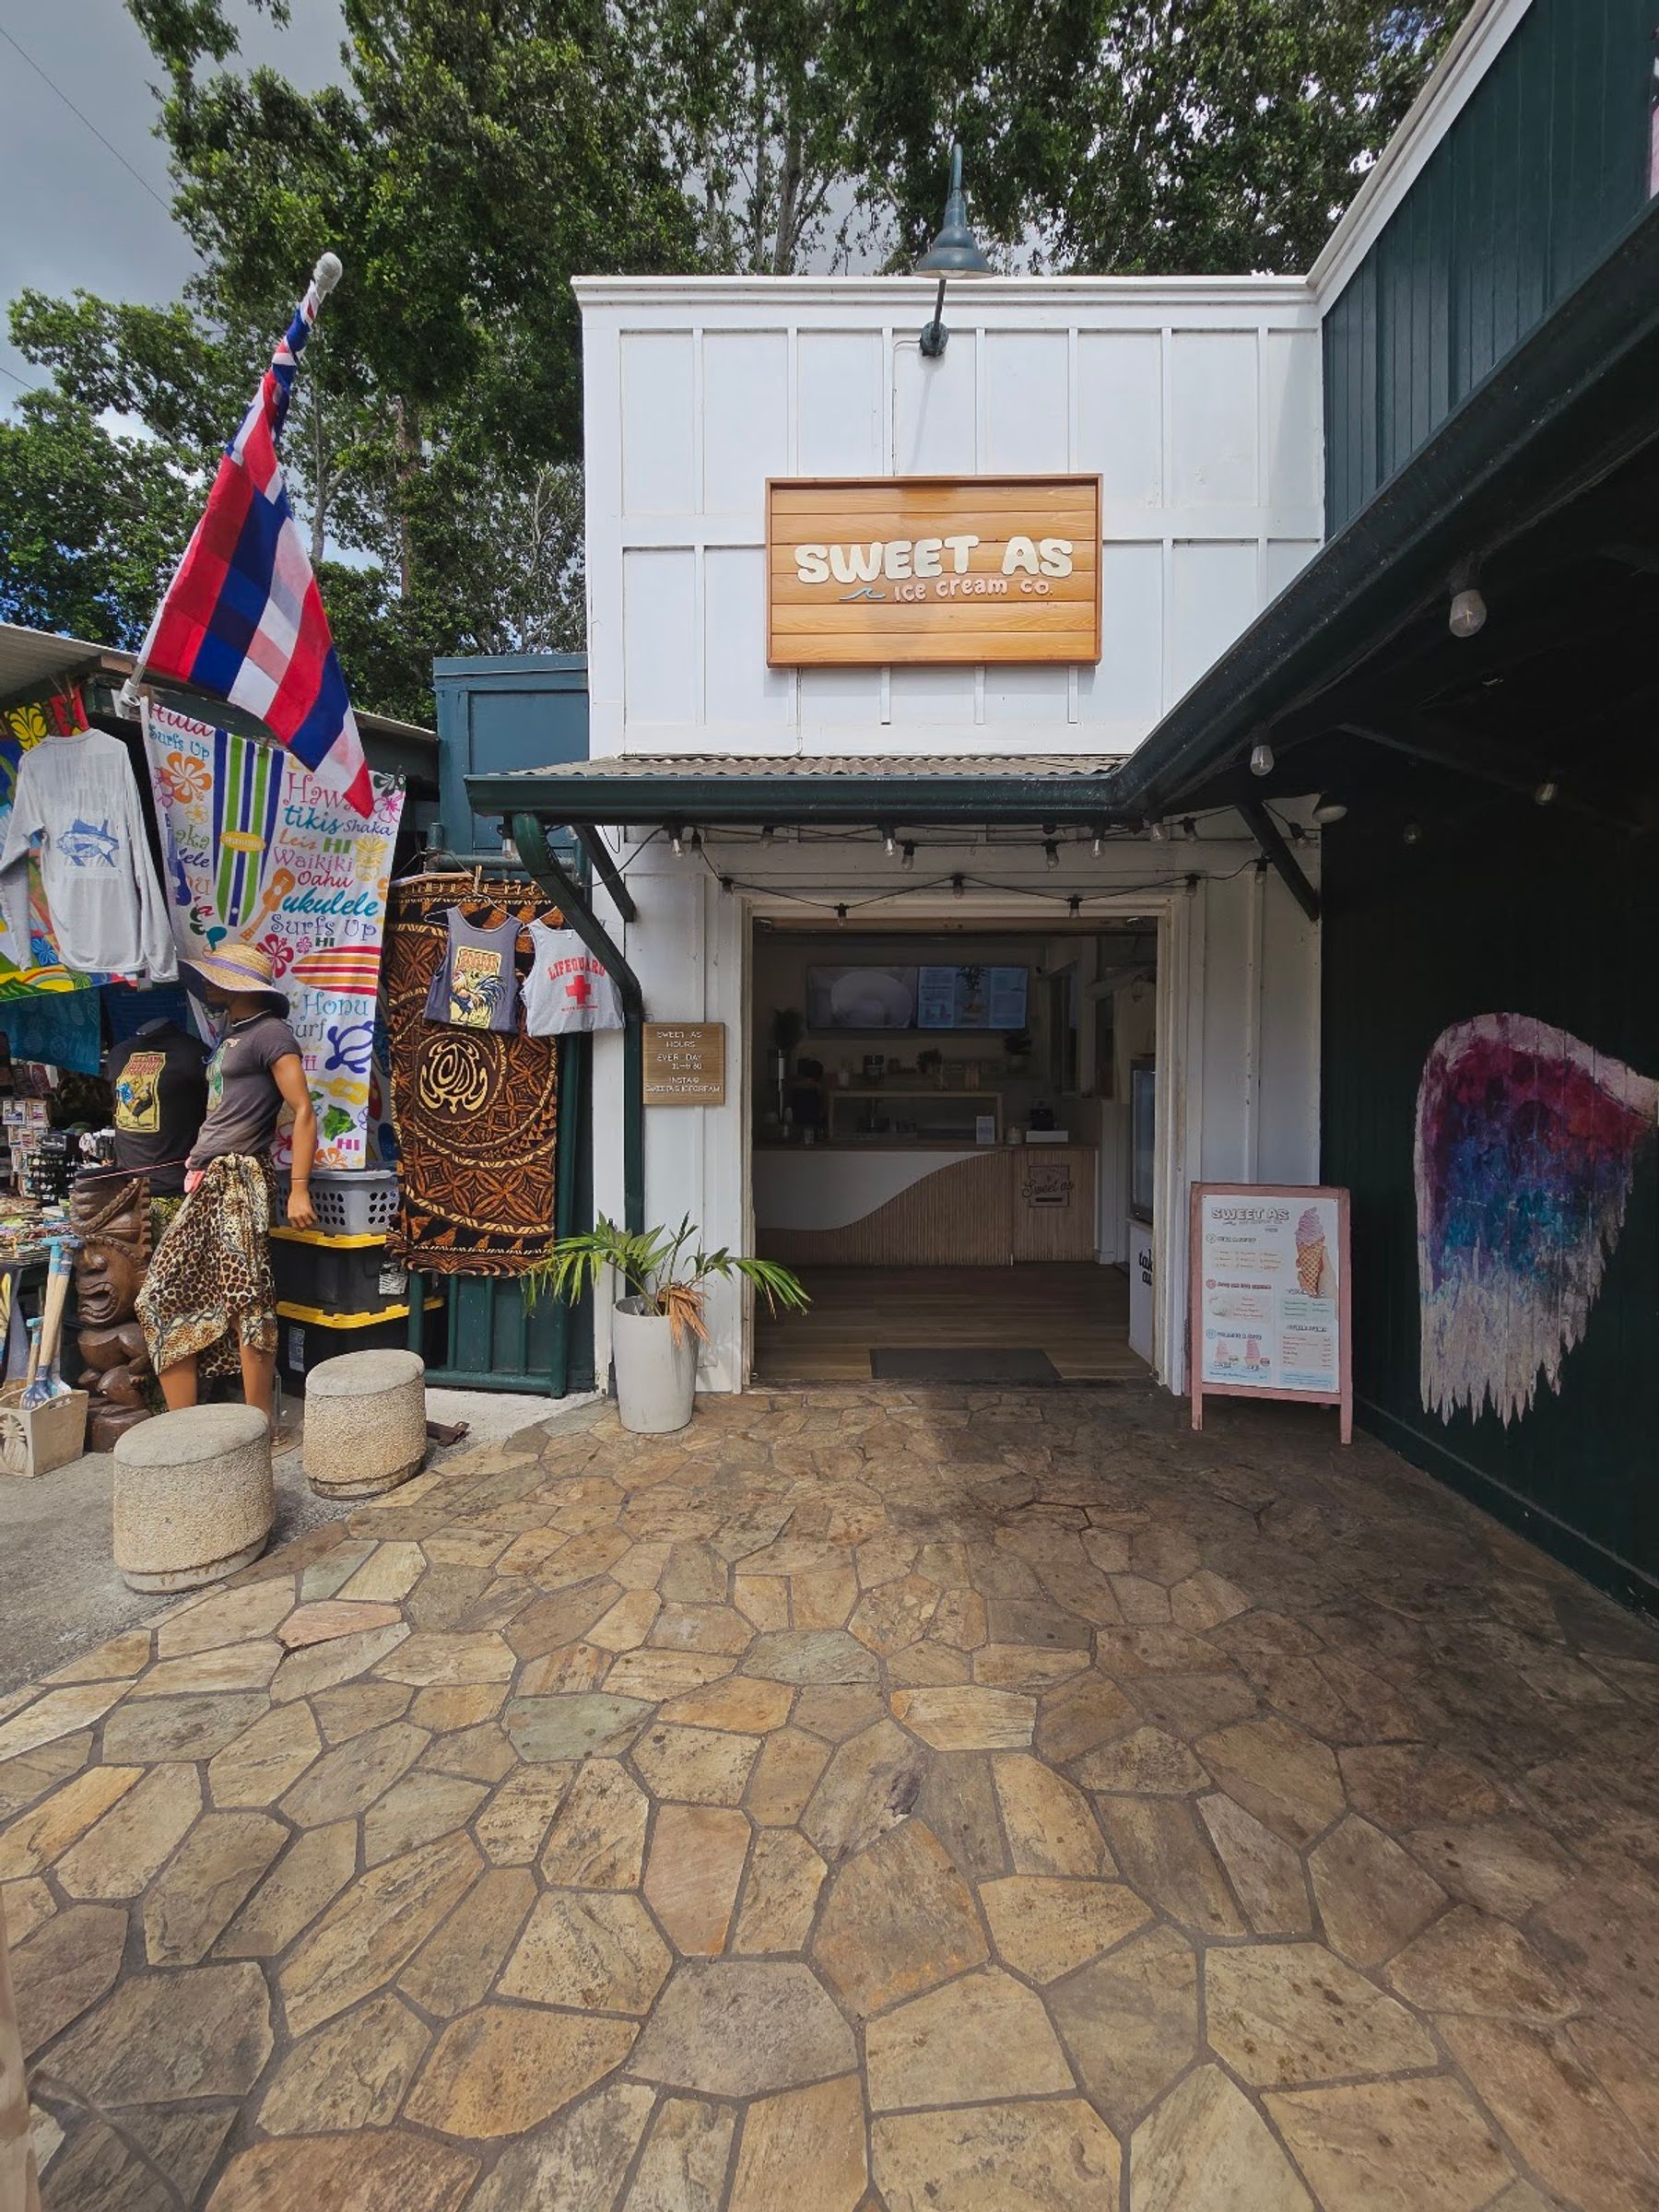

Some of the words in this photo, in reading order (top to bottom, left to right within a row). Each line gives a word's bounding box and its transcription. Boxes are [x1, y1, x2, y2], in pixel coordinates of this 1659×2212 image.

[794, 535, 979, 583] SWEET
[1002, 536, 1073, 578] AS
[936, 578, 1007, 596] cream
[148, 724, 184, 752] Surfs
[190, 740, 210, 761] Up
[285, 805, 344, 835] tikis
[279, 828, 316, 850] Leis
[324, 837, 352, 853] HI
[274, 846, 353, 872] Waikiki
[297, 871, 353, 888] Oahu
[282, 887, 379, 917] ukulele
[271, 914, 335, 936] Surfs
[344, 919, 377, 941] Up
[315, 937, 335, 947] HI
[300, 992, 369, 1021] Honu
[337, 1138, 359, 1151] HI
[1212, 1207, 1265, 1220] SWEET
[1267, 1207, 1289, 1220] AS
